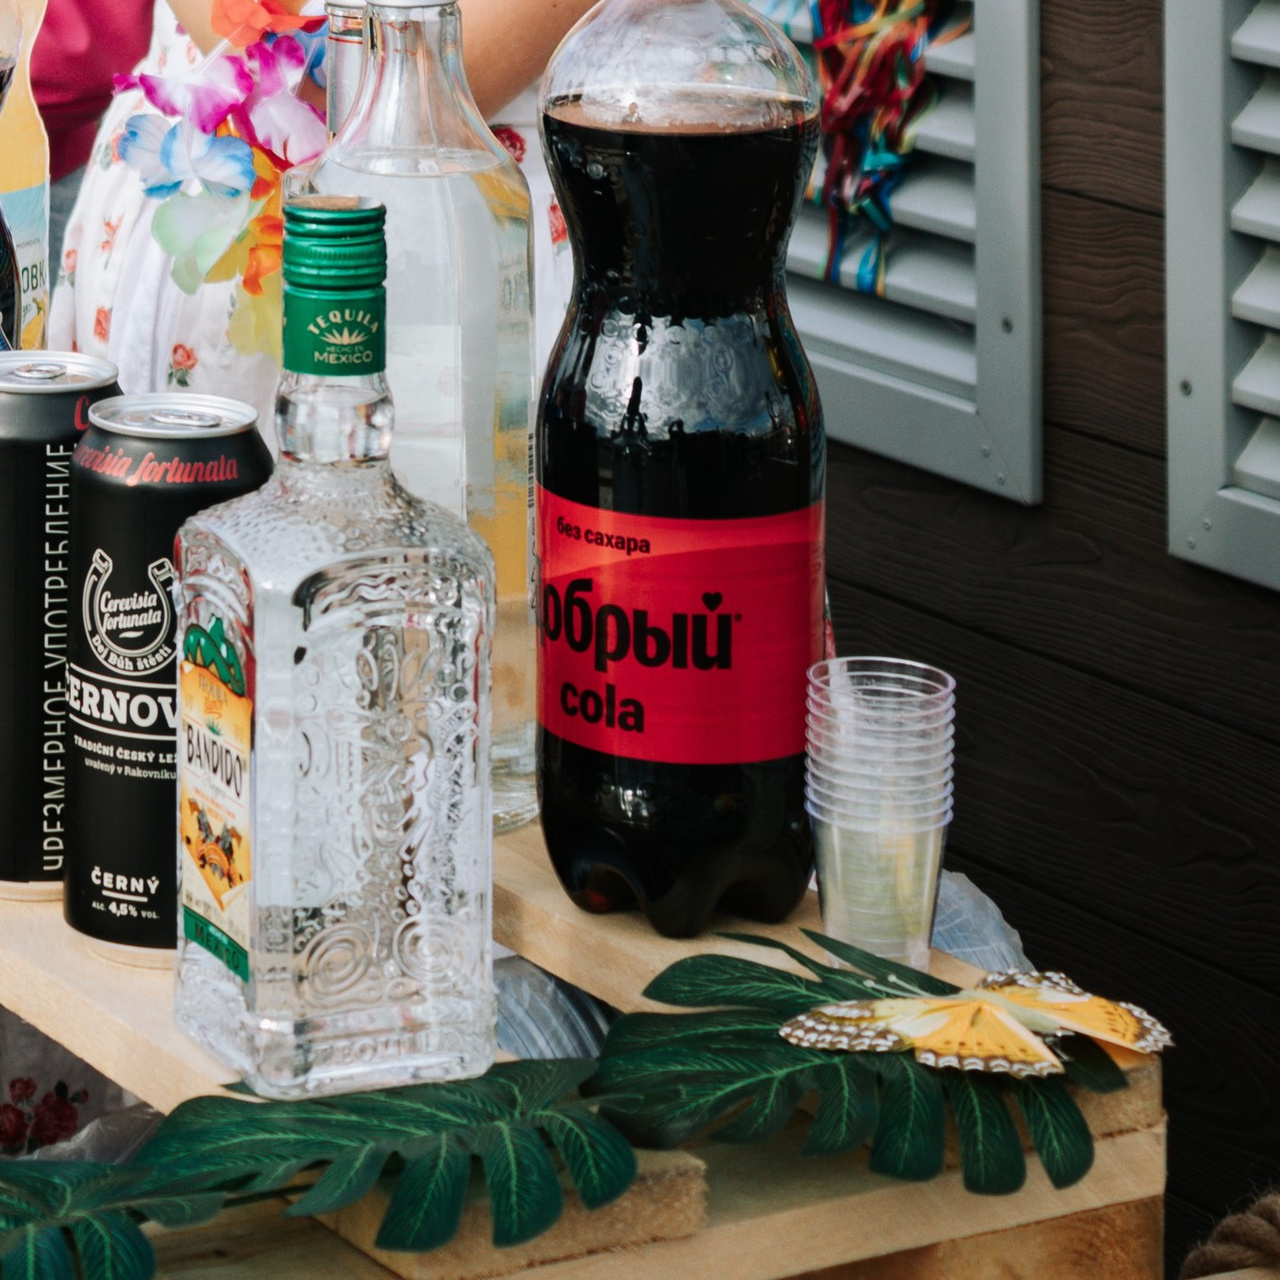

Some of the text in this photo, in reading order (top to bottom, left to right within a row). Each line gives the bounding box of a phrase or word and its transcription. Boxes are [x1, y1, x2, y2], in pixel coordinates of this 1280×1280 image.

[307, 308, 379, 335] TEQUILA
[314, 350, 374, 365] MEXICO
[125, 452, 239, 487] fortunata
[556, 516, 651, 556] без сахара
[100, 590, 158, 613] Cerevisia
[102, 608, 162, 634] fortunata
[91, 633, 110, 660] Dej
[108, 651, 135, 671] Bůh
[65, 663, 178, 729] ERNOV
[560, 681, 645, 734] cola
[73, 734, 115, 758] TRADIČNÍ
[116, 746, 156, 764] ČESKÝ
[187, 724, 243, 798] BANDIDO
[117, 766, 123, 774] v
[91, 865, 160, 895] ČERNÝ
[108, 901, 138, 918] 4,5%
